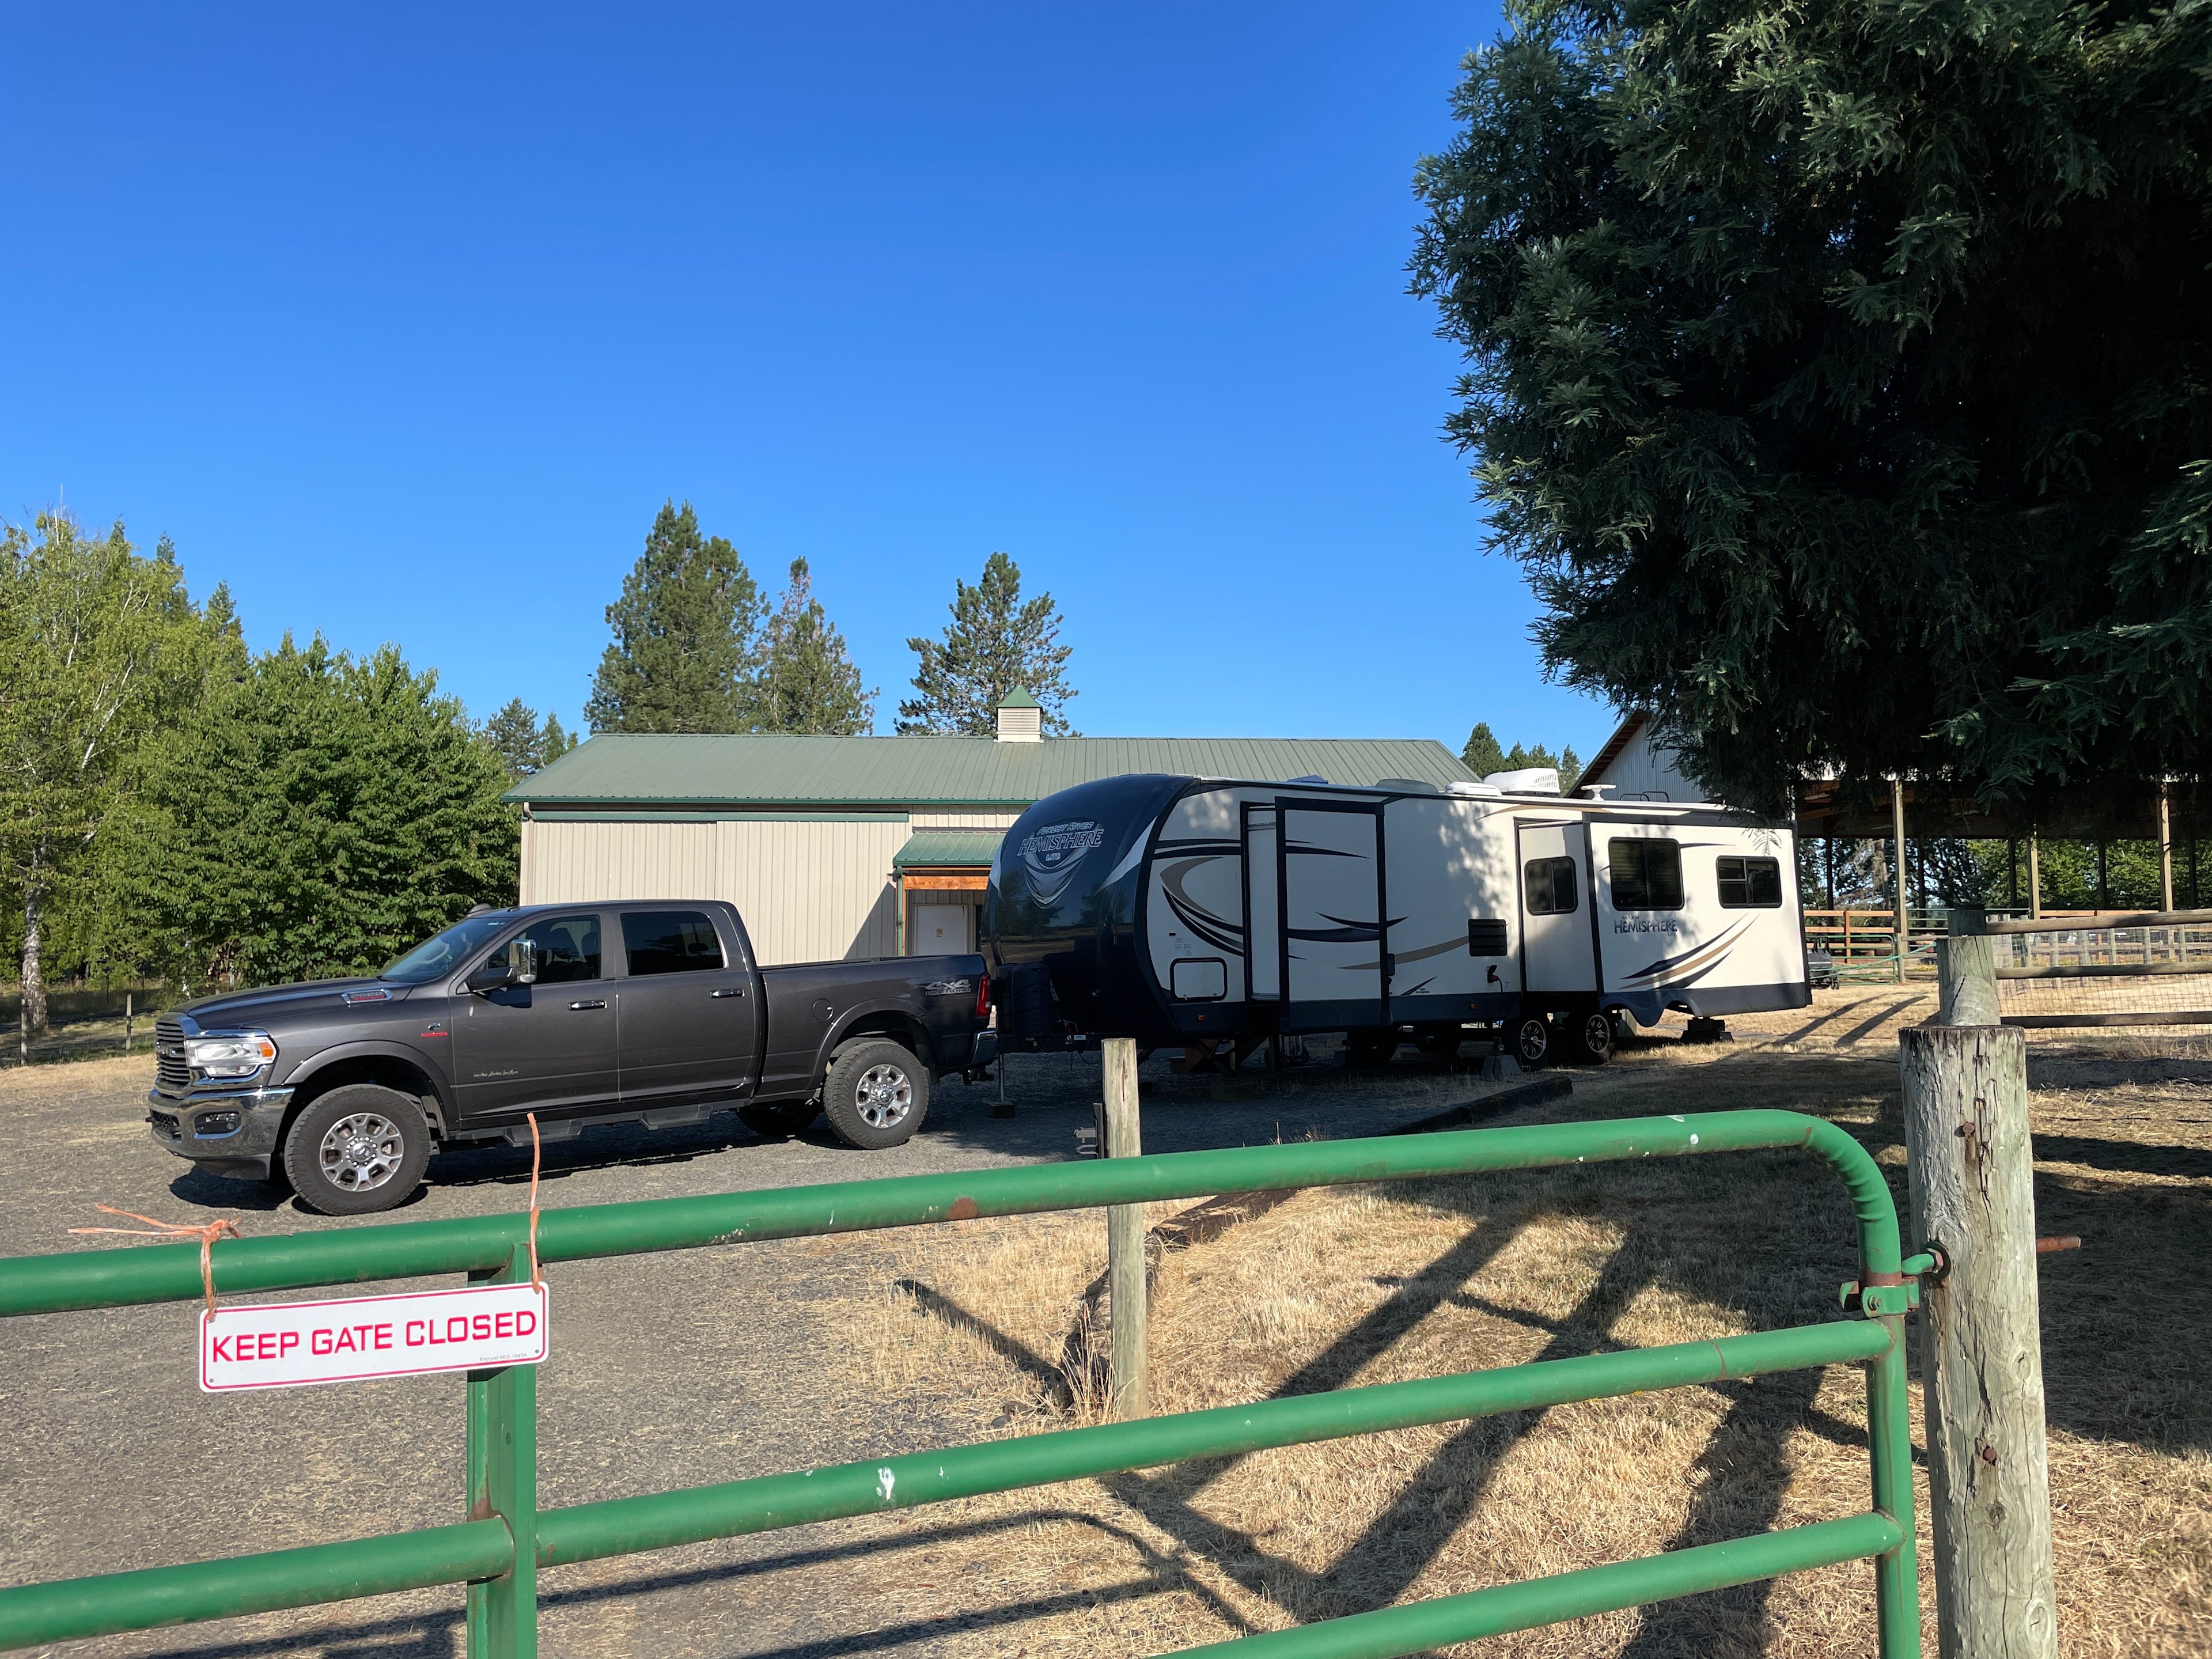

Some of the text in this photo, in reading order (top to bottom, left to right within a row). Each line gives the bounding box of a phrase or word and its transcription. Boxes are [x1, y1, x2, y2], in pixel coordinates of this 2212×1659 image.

[1067, 821, 1094, 831] RIVER
[1017, 829, 1104, 857] HEMISPHERE
[1046, 853, 1061, 861] LITE
[1613, 920, 1677, 934] HEMISPHERE
[213, 1310, 536, 1363] KEEP GATE CLOSED
